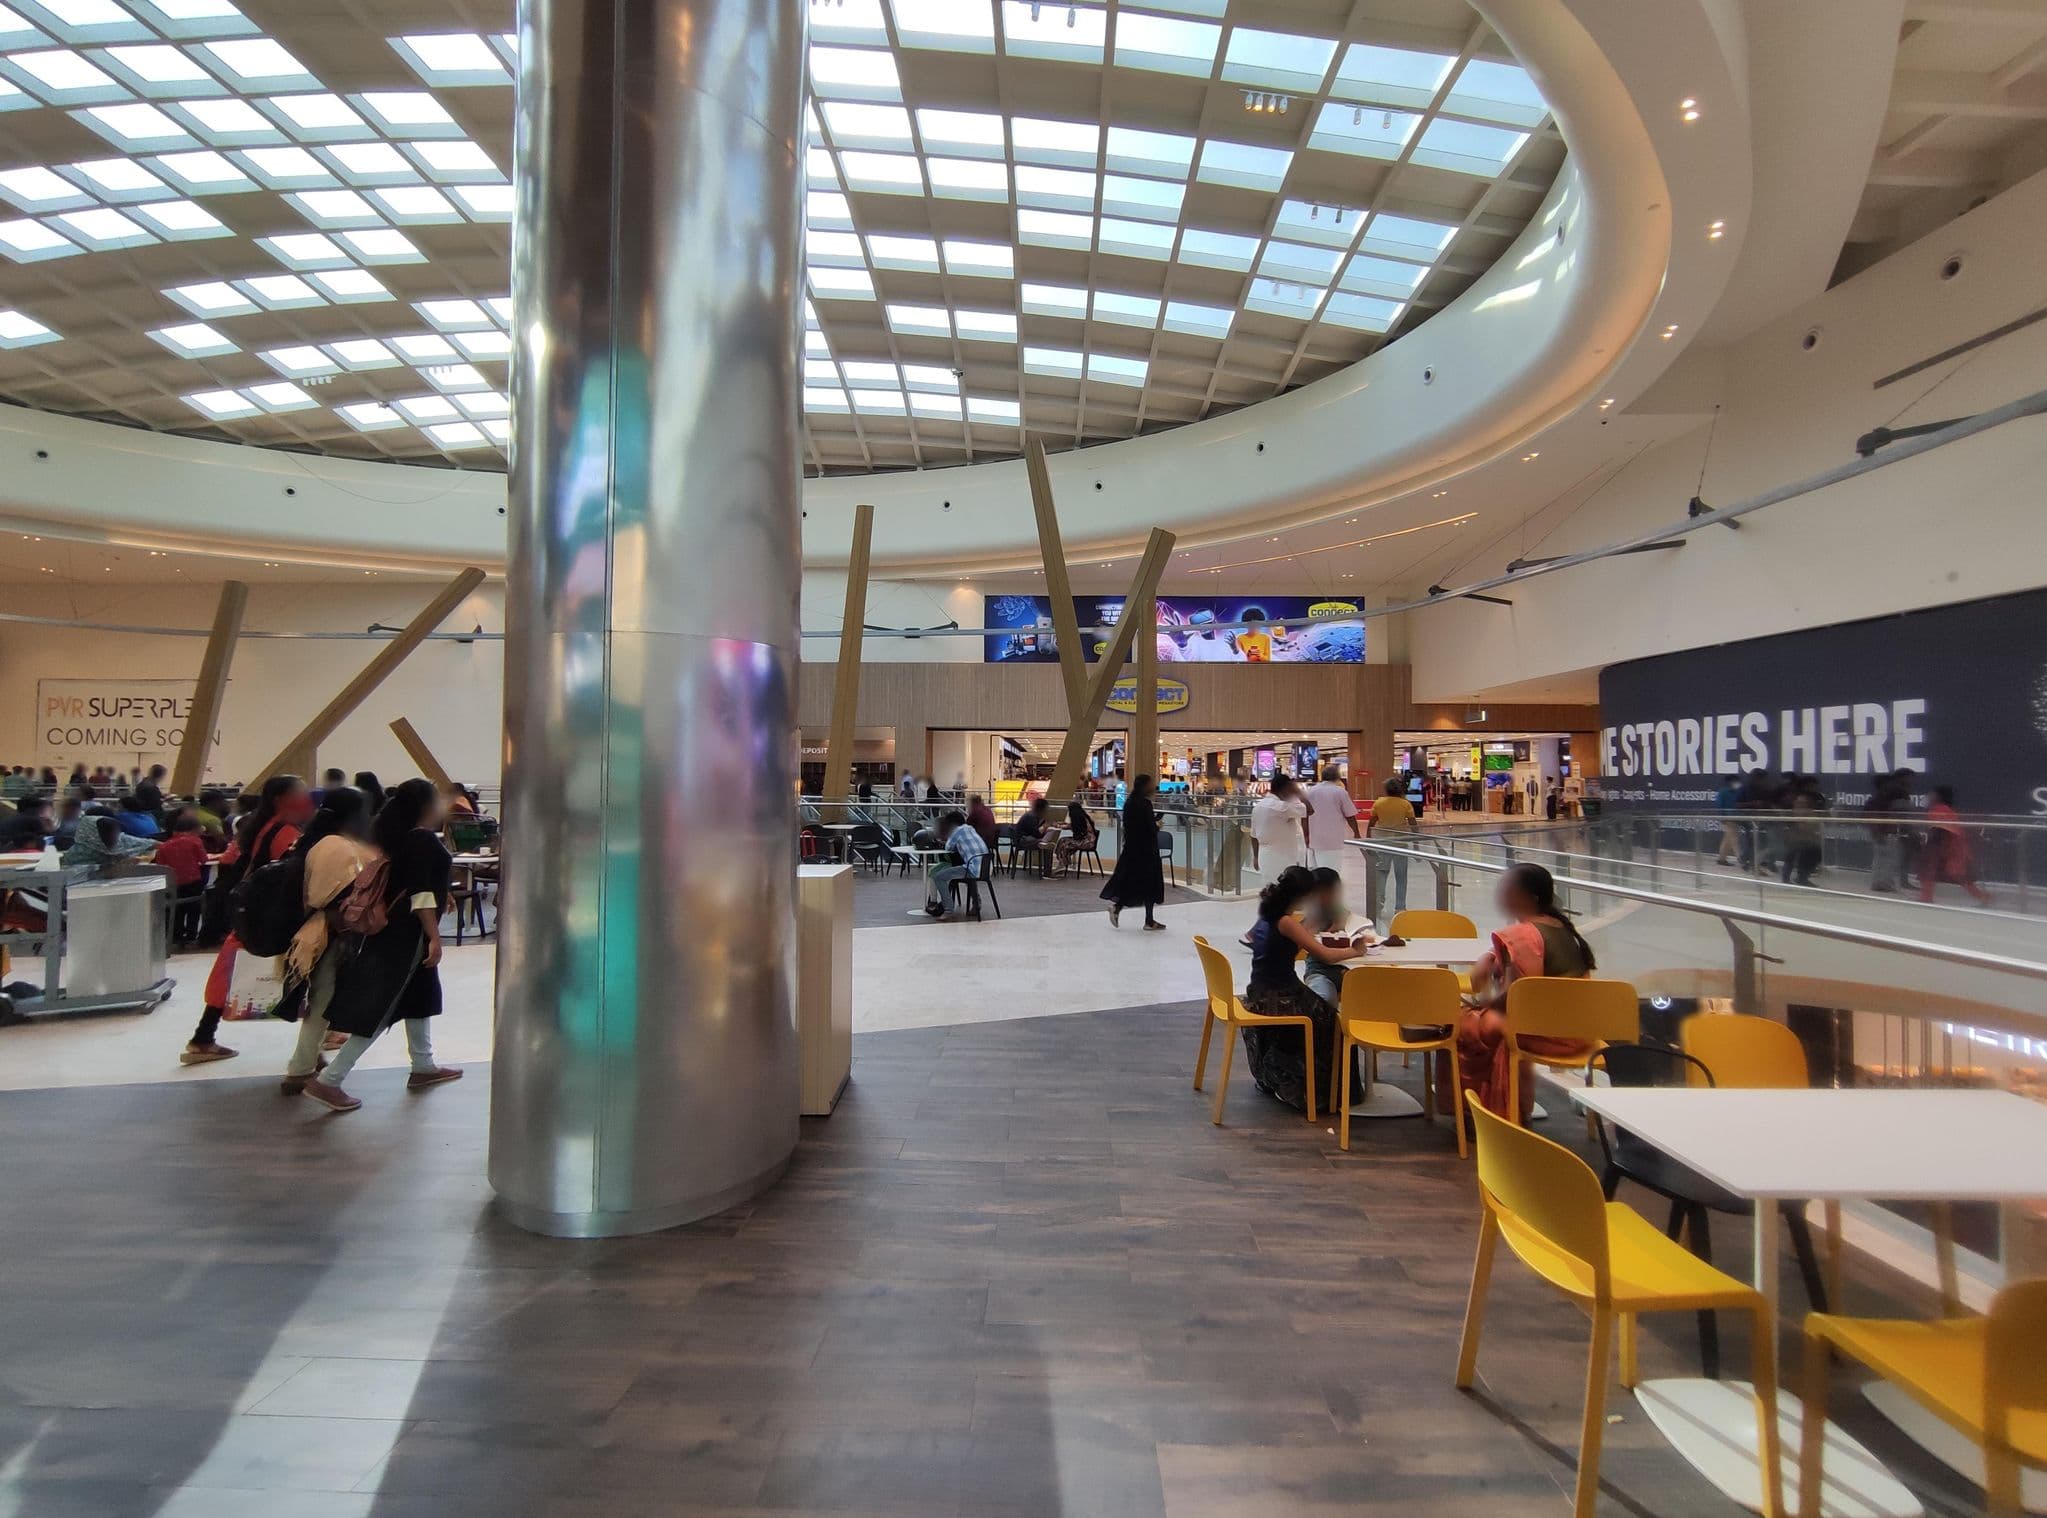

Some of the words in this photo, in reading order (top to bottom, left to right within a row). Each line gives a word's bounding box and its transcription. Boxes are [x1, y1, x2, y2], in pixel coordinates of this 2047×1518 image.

[47, 698, 84, 718] PVR
[89, 697, 194, 719] SUPERPLE
[47, 727, 148, 746] COMING
[156, 728, 221, 747] SON
[1621, 711, 1769, 776] STORIES
[1781, 699, 1926, 774] HERE
[1671, 788, 1718, 802] Accessorie
